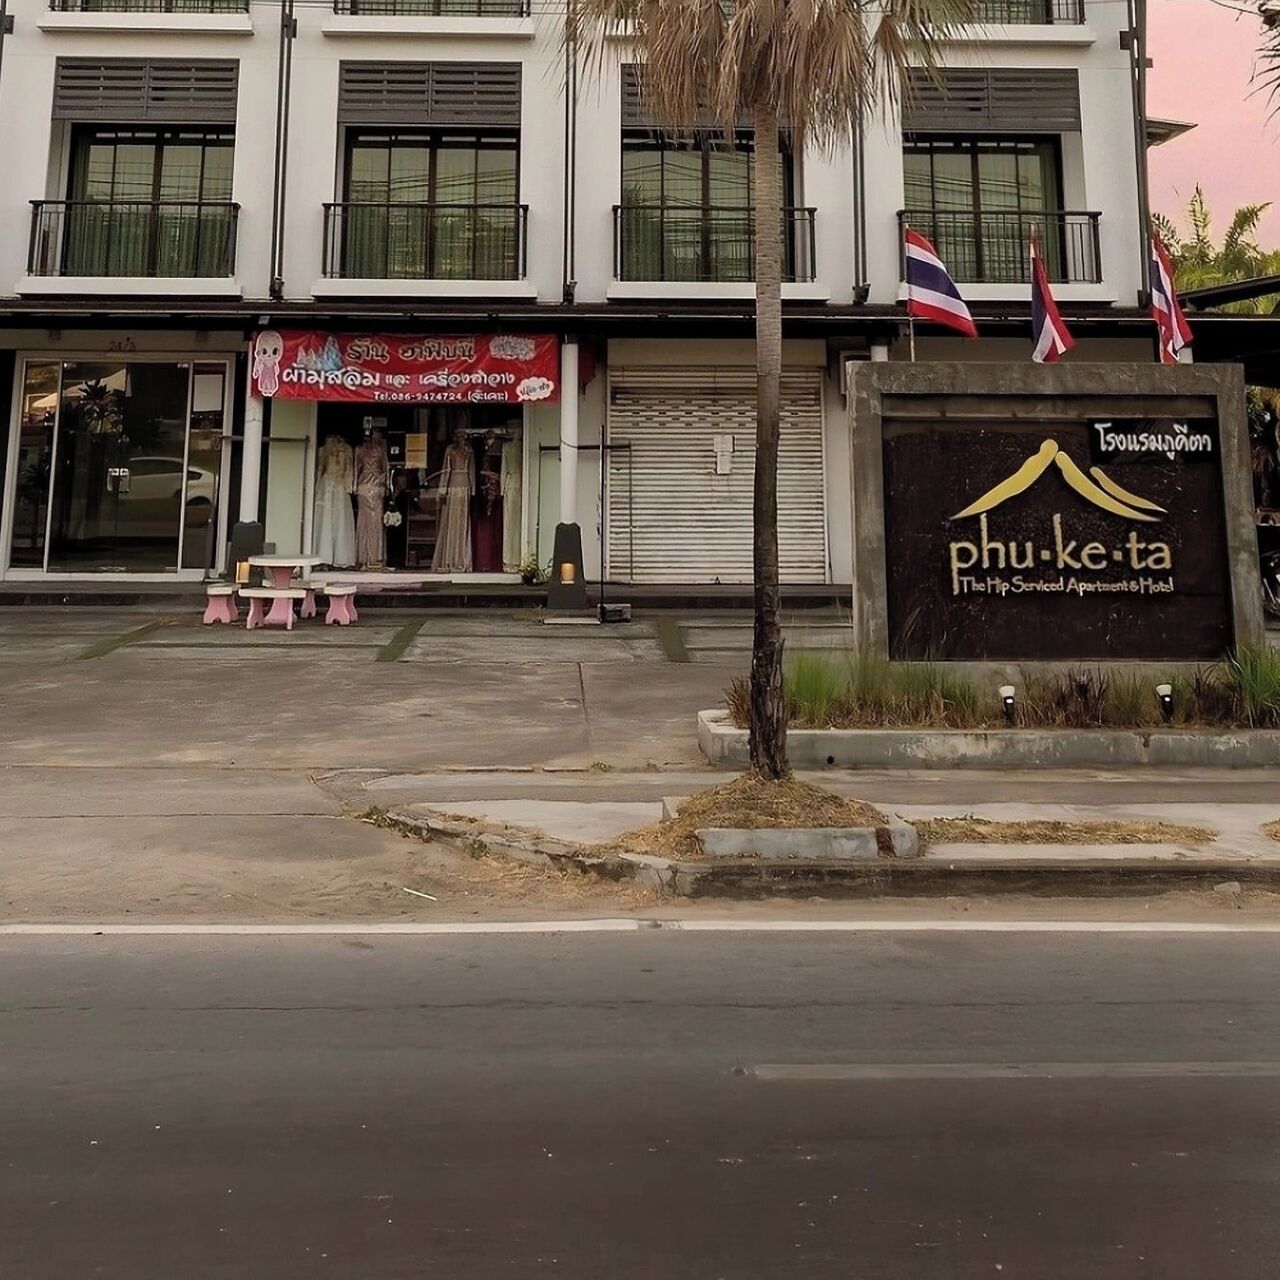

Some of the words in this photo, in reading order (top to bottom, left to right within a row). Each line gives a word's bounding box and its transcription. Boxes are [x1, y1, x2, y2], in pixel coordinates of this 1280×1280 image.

[346, 337, 389, 363] ร้าน
[385, 373, 411, 388] และ
[1094, 422, 1211, 460] โรงแรมภูคีตา
[959, 576, 985, 593] The
[987, 577, 1009, 596] Hip
[1011, 576, 1064, 593] Serviced
[1066, 577, 1128, 596] Apartment
[1140, 576, 1174, 594] Hotel
